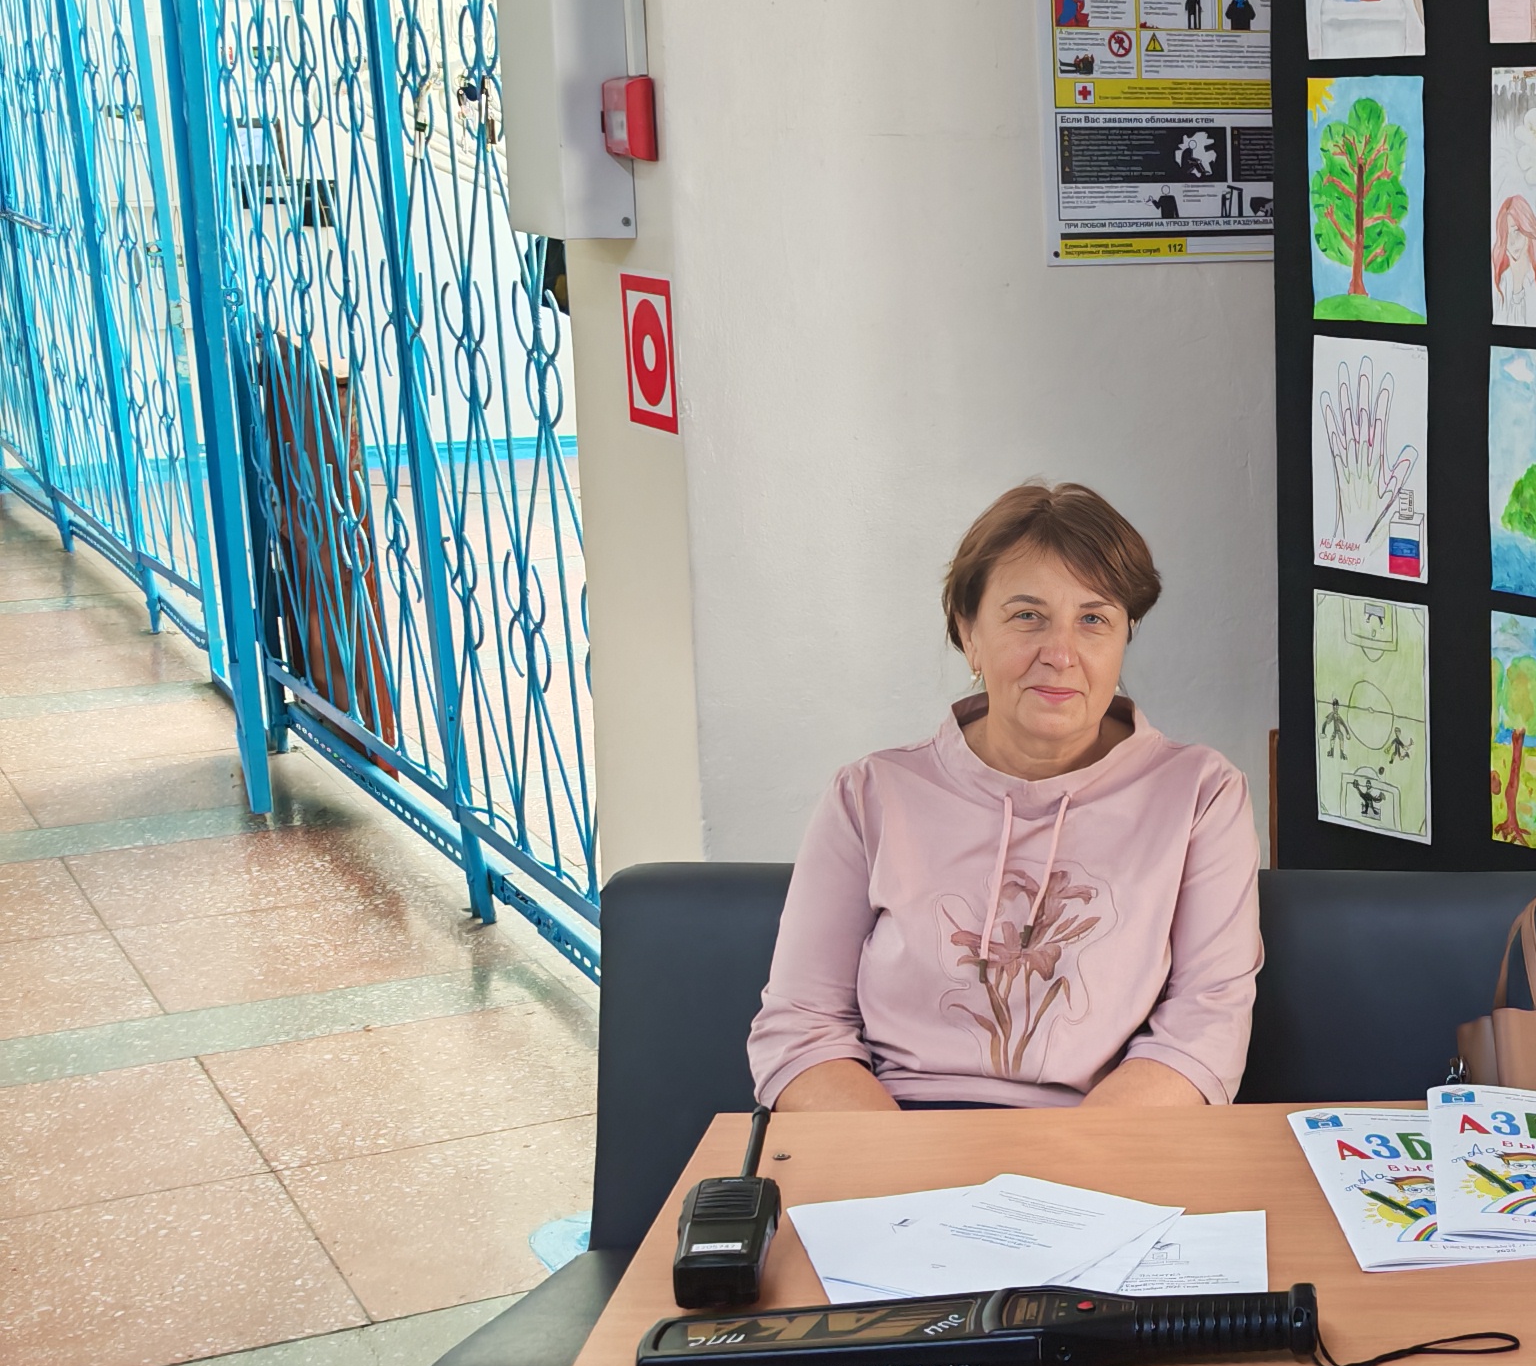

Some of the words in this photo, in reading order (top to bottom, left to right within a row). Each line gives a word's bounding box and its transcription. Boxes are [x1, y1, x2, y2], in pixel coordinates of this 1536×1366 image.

[1060, 116, 1082, 124] Если
[1084, 116, 1100, 124] Вас
[1145, 116, 1193, 124] обломками
[1167, 243, 1183, 253] 112
